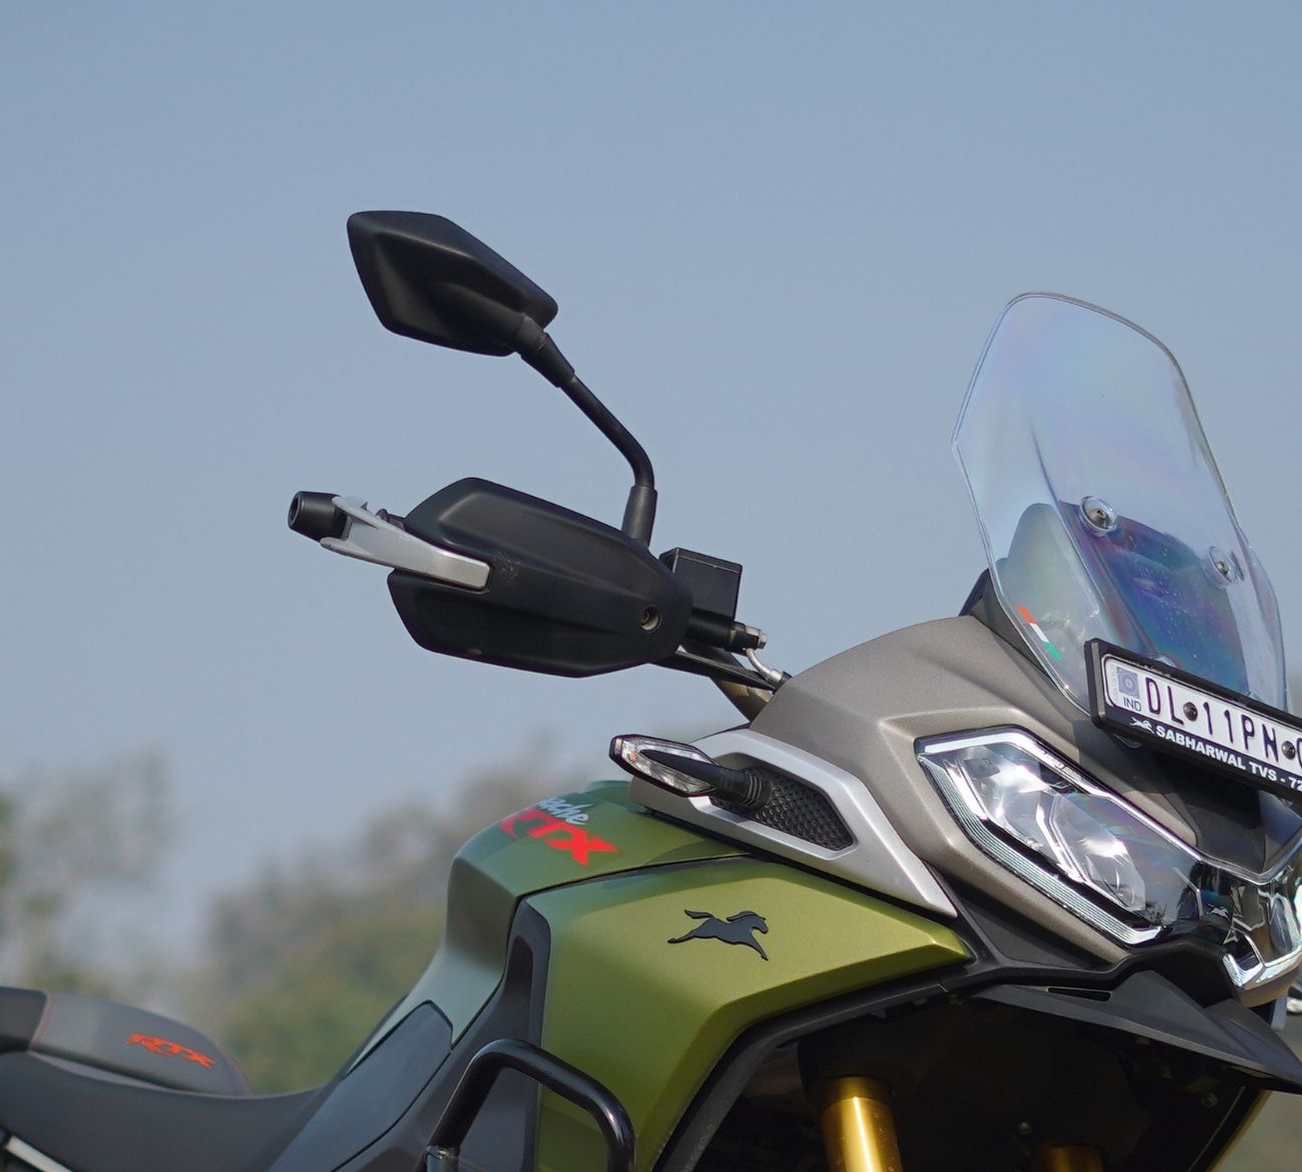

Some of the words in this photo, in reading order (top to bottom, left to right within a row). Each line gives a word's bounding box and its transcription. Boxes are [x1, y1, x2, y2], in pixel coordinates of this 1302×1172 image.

[1123, 696, 1141, 711] IND
[1156, 725, 1246, 770] SABHARWAL
[1249, 762, 1277, 782] TVS
